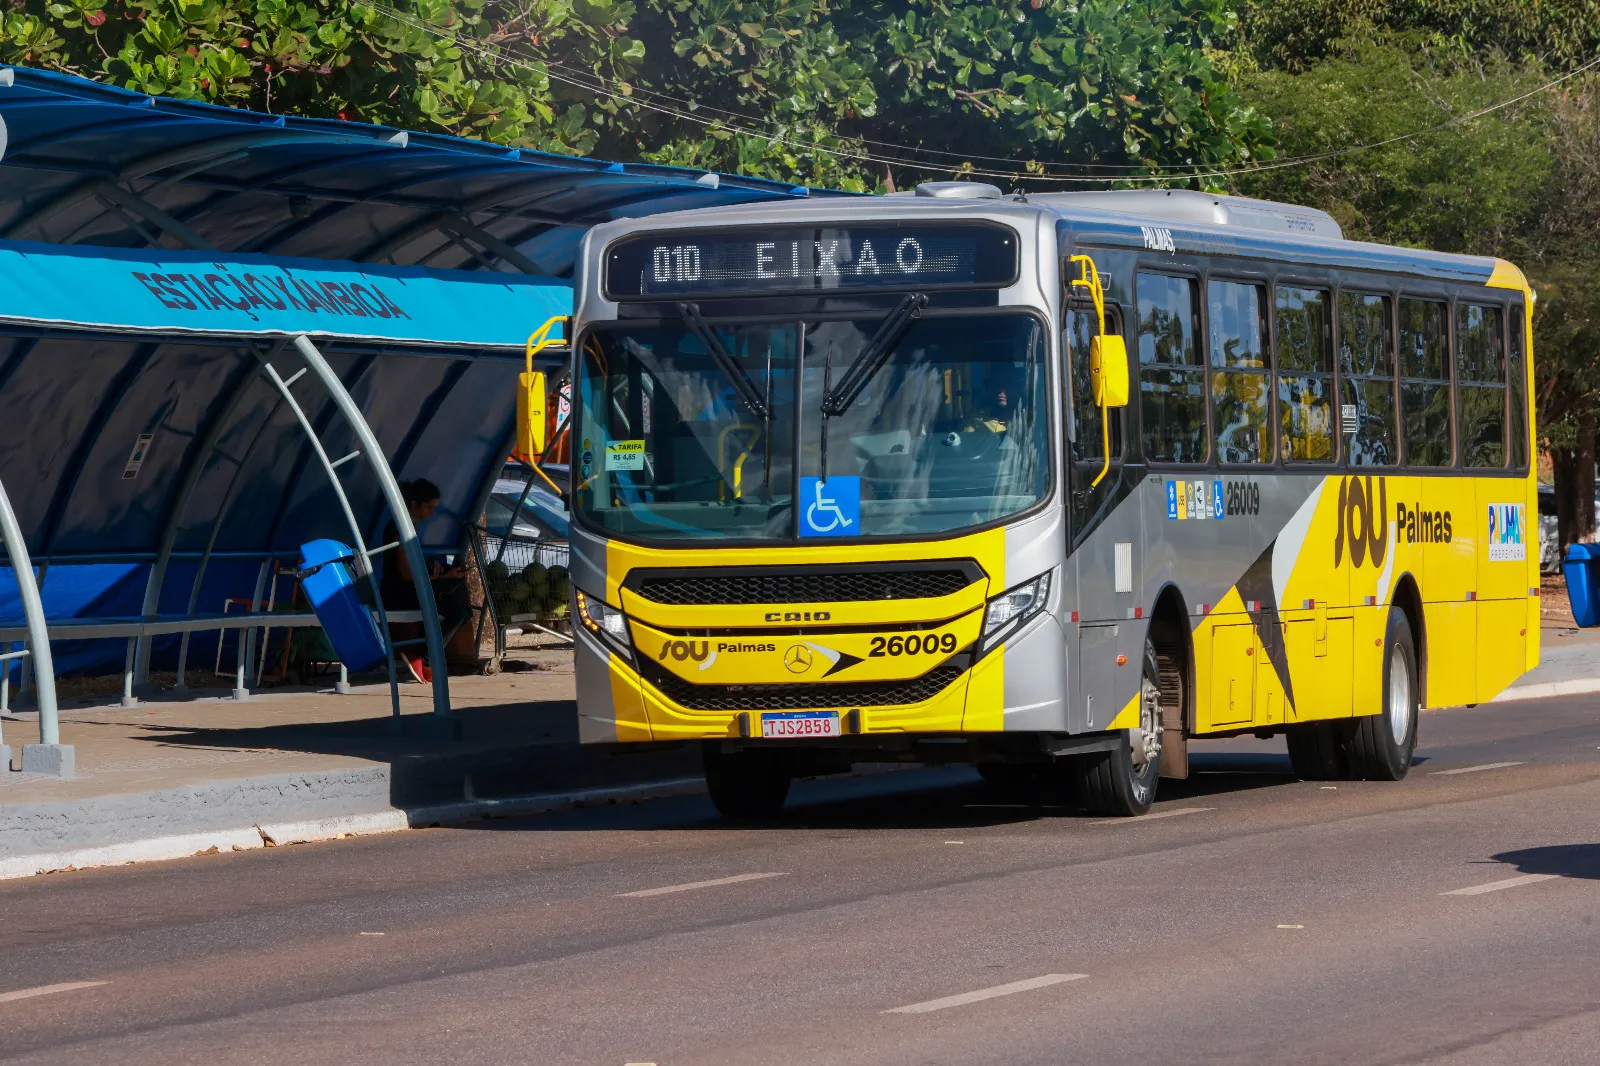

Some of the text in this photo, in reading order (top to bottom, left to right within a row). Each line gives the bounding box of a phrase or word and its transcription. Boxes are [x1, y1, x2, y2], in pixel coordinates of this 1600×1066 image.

[653, 237, 923, 282] 010 EIXAO
[1227, 481, 1260, 515] 26009
[1396, 502, 1452, 543] Palmas
[1488, 505, 1525, 544] PALMAS
[764, 611, 832, 622] CAIO
[717, 641, 776, 653] Palmas
[868, 632, 958, 658] 26009
[768, 719, 832, 735] TJS2B58
